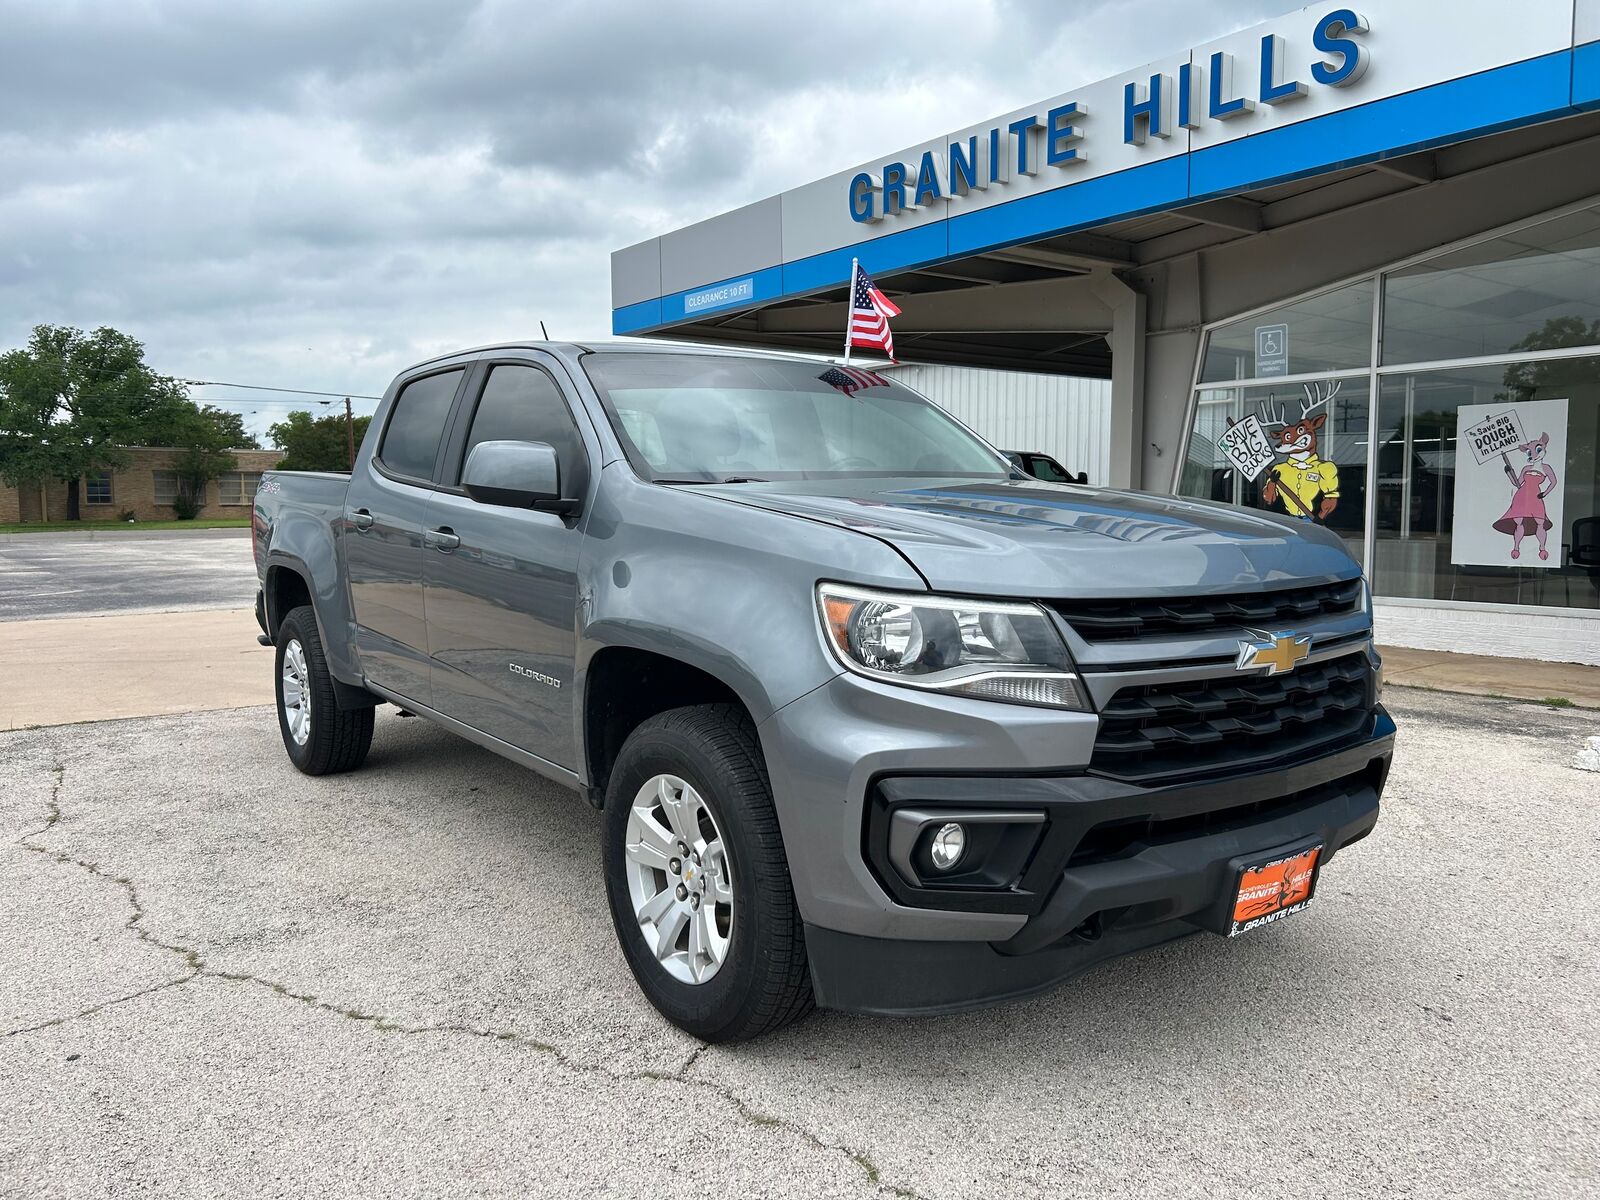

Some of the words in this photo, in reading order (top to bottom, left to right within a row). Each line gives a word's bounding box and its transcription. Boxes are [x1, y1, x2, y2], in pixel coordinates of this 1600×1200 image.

[849, 102, 1082, 224] GRANITE
[1124, 8, 1362, 146] HILLS
[688, 289, 728, 307] CLEARANCE
[729, 287, 738, 297] 10
[738, 284, 748, 296] FT
[1225, 418, 1258, 448] SAVE
[1474, 422, 1516, 450] DOUGH
[1476, 423, 1496, 436] Save
[1496, 416, 1510, 427] BIG
[1231, 434, 1263, 464] BIG
[1480, 448, 1490, 456] in
[1489, 433, 1520, 452] LLANO!
[1242, 445, 1273, 477] BUCKS
[509, 663, 561, 688] COLORADO
[1237, 886, 1280, 903] GRANITE
[1291, 869, 1313, 884] HILLS
[1245, 882, 1273, 893] CHEVROLET
[1244, 908, 1286, 931] GRANITE
[1286, 899, 1314, 916] HILLS
